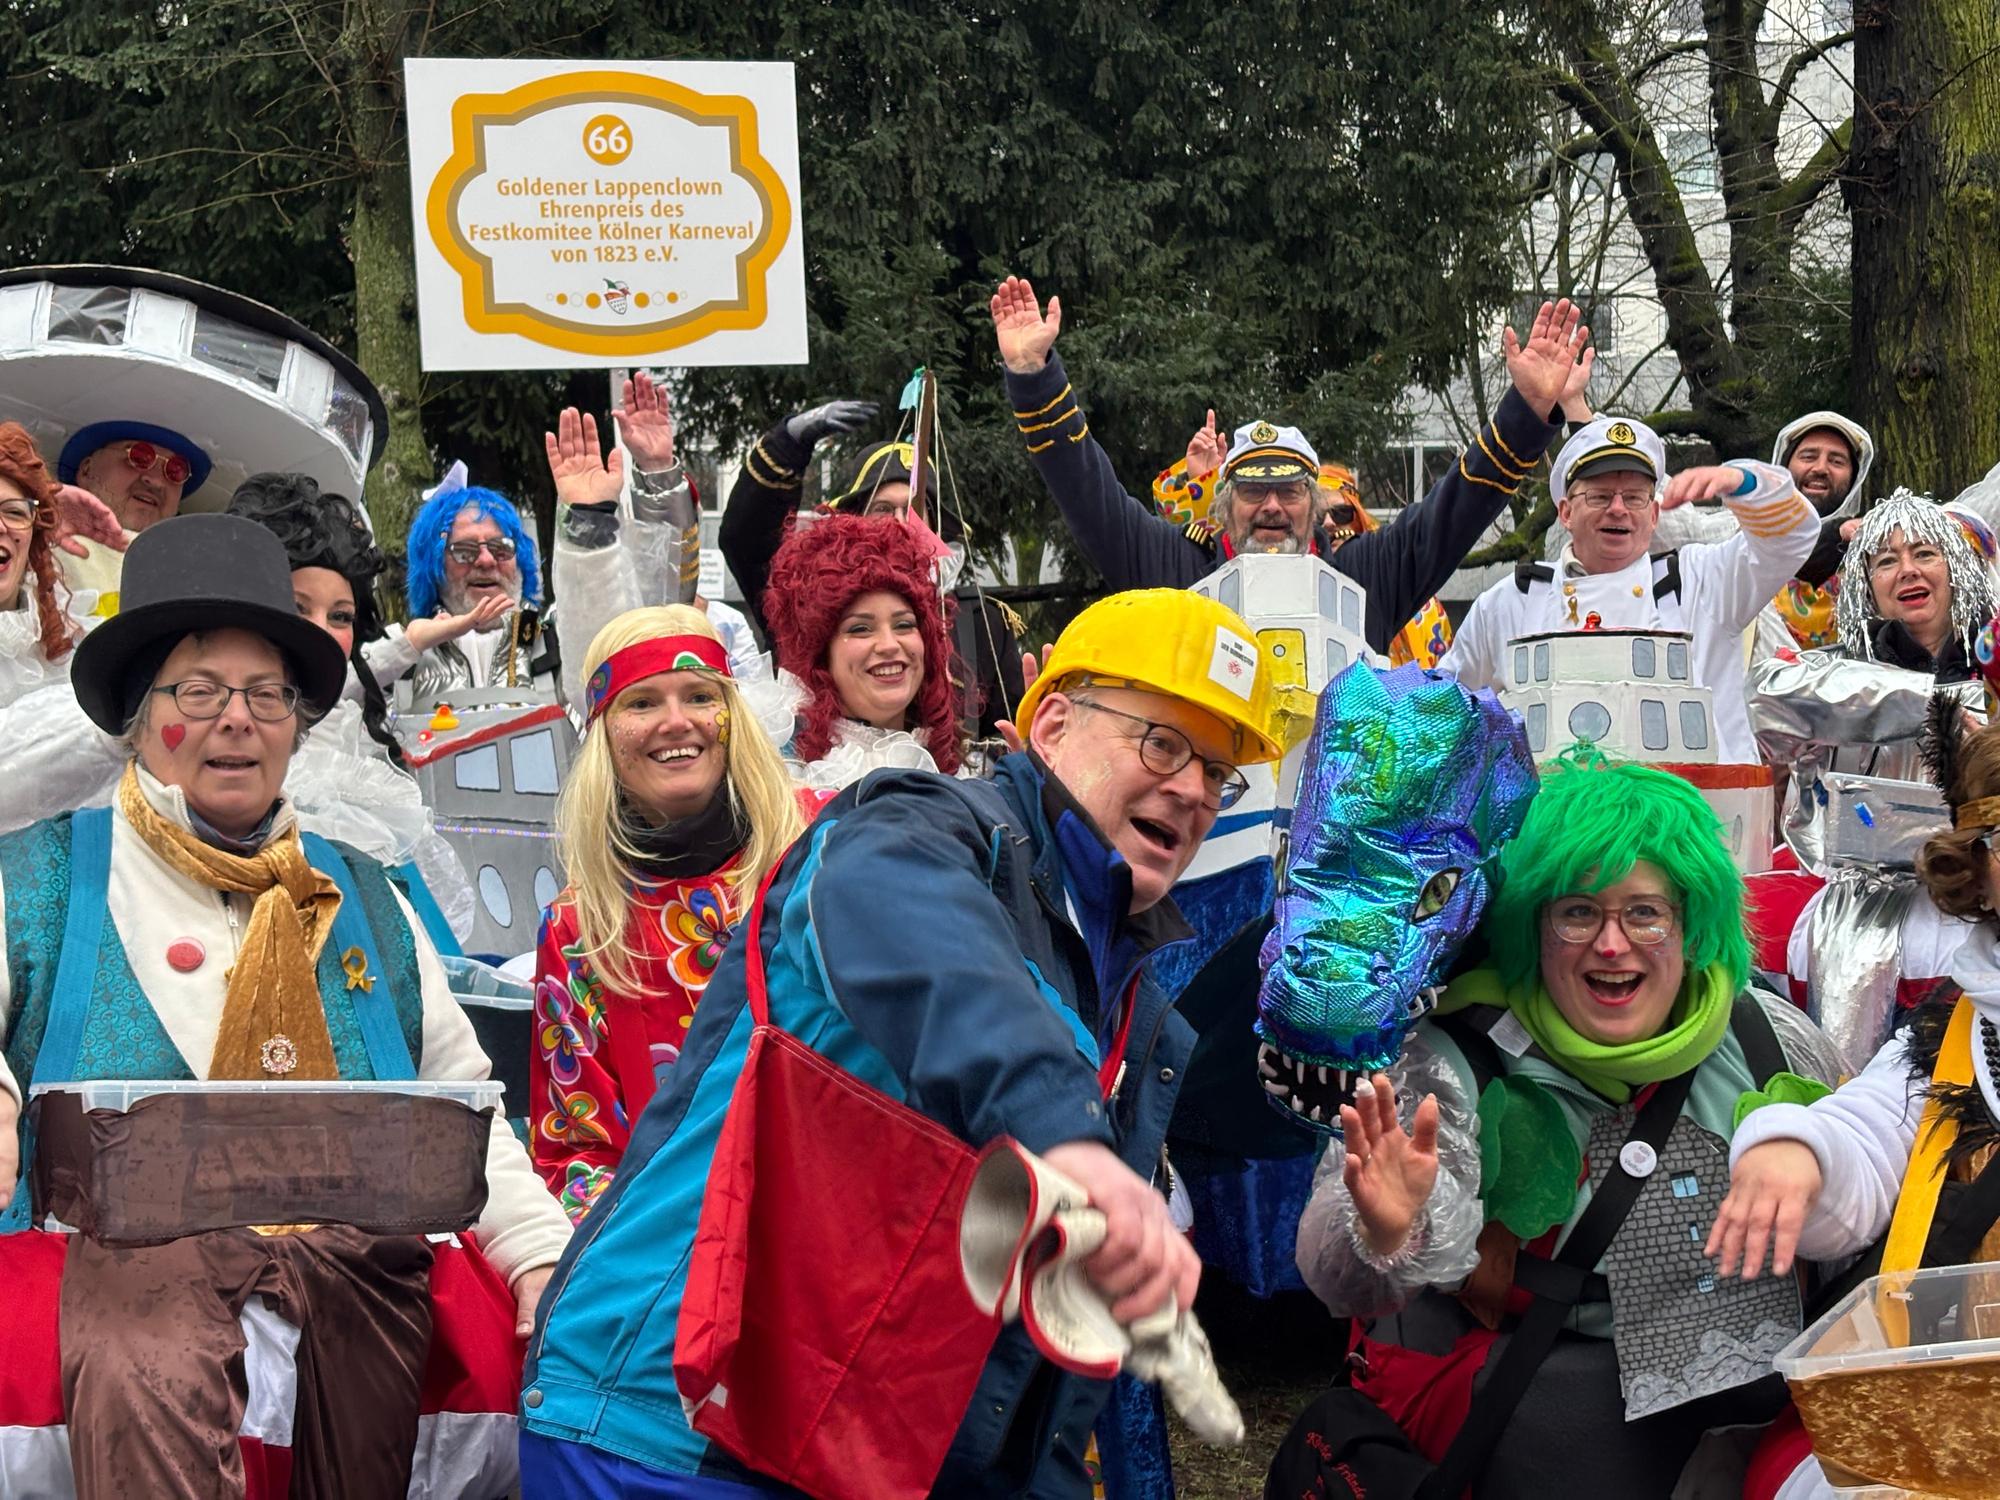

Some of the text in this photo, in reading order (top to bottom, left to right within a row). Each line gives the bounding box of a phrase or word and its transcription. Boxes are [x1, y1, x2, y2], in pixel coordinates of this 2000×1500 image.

[588, 126, 628, 154] 66
[496, 178, 723, 201] Goldener Lappenclown
[540, 199, 684, 222] Ehrenpreis des
[469, 221, 754, 241] Festkomitee Kölner Karneval
[551, 245, 679, 263] von 1823 e.V.
